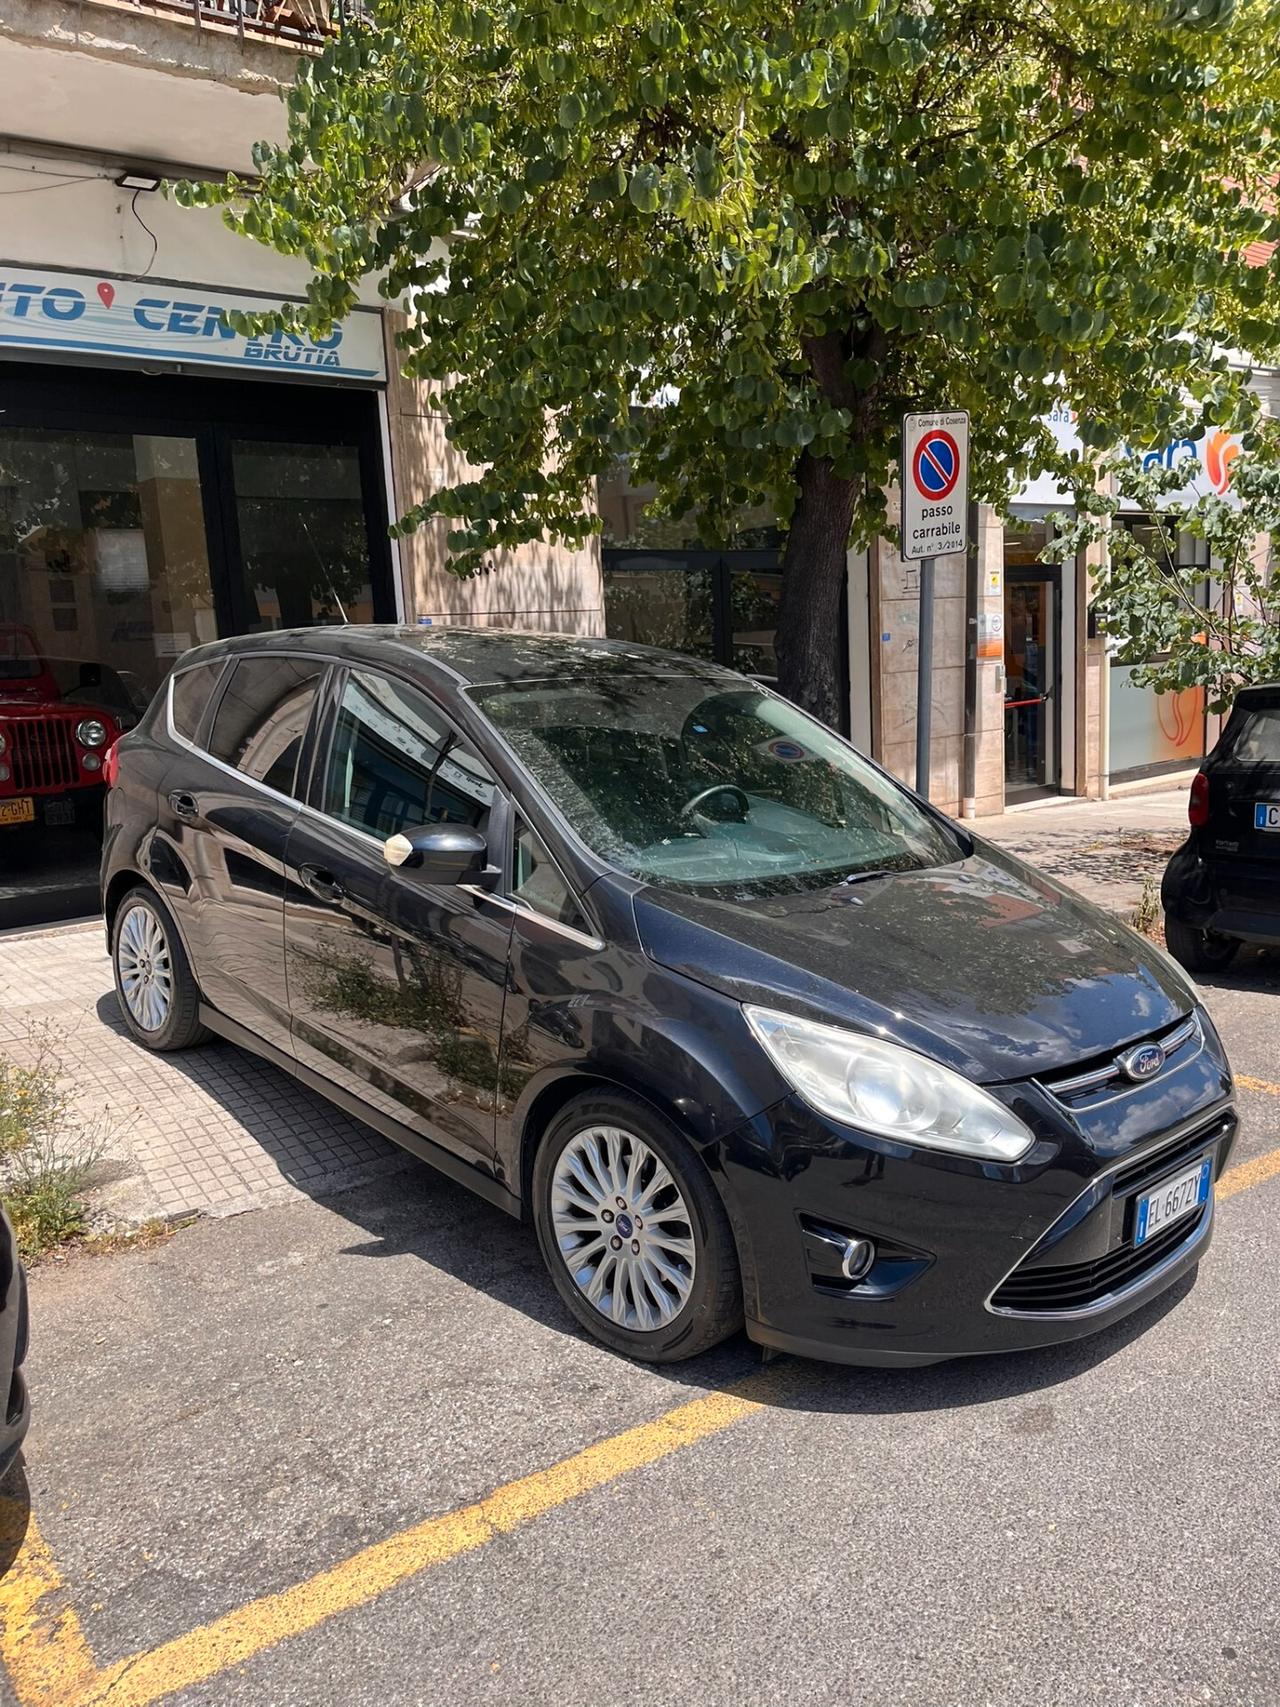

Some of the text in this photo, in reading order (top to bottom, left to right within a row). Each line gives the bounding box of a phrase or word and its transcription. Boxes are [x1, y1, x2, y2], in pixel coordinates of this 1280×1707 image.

[0, 282, 86, 321] TO
[244, 341, 341, 367] BRUTIA
[921, 505, 953, 521] passo
[912, 521, 961, 540] carrabile
[1140, 1050, 1160, 1073] Ford
